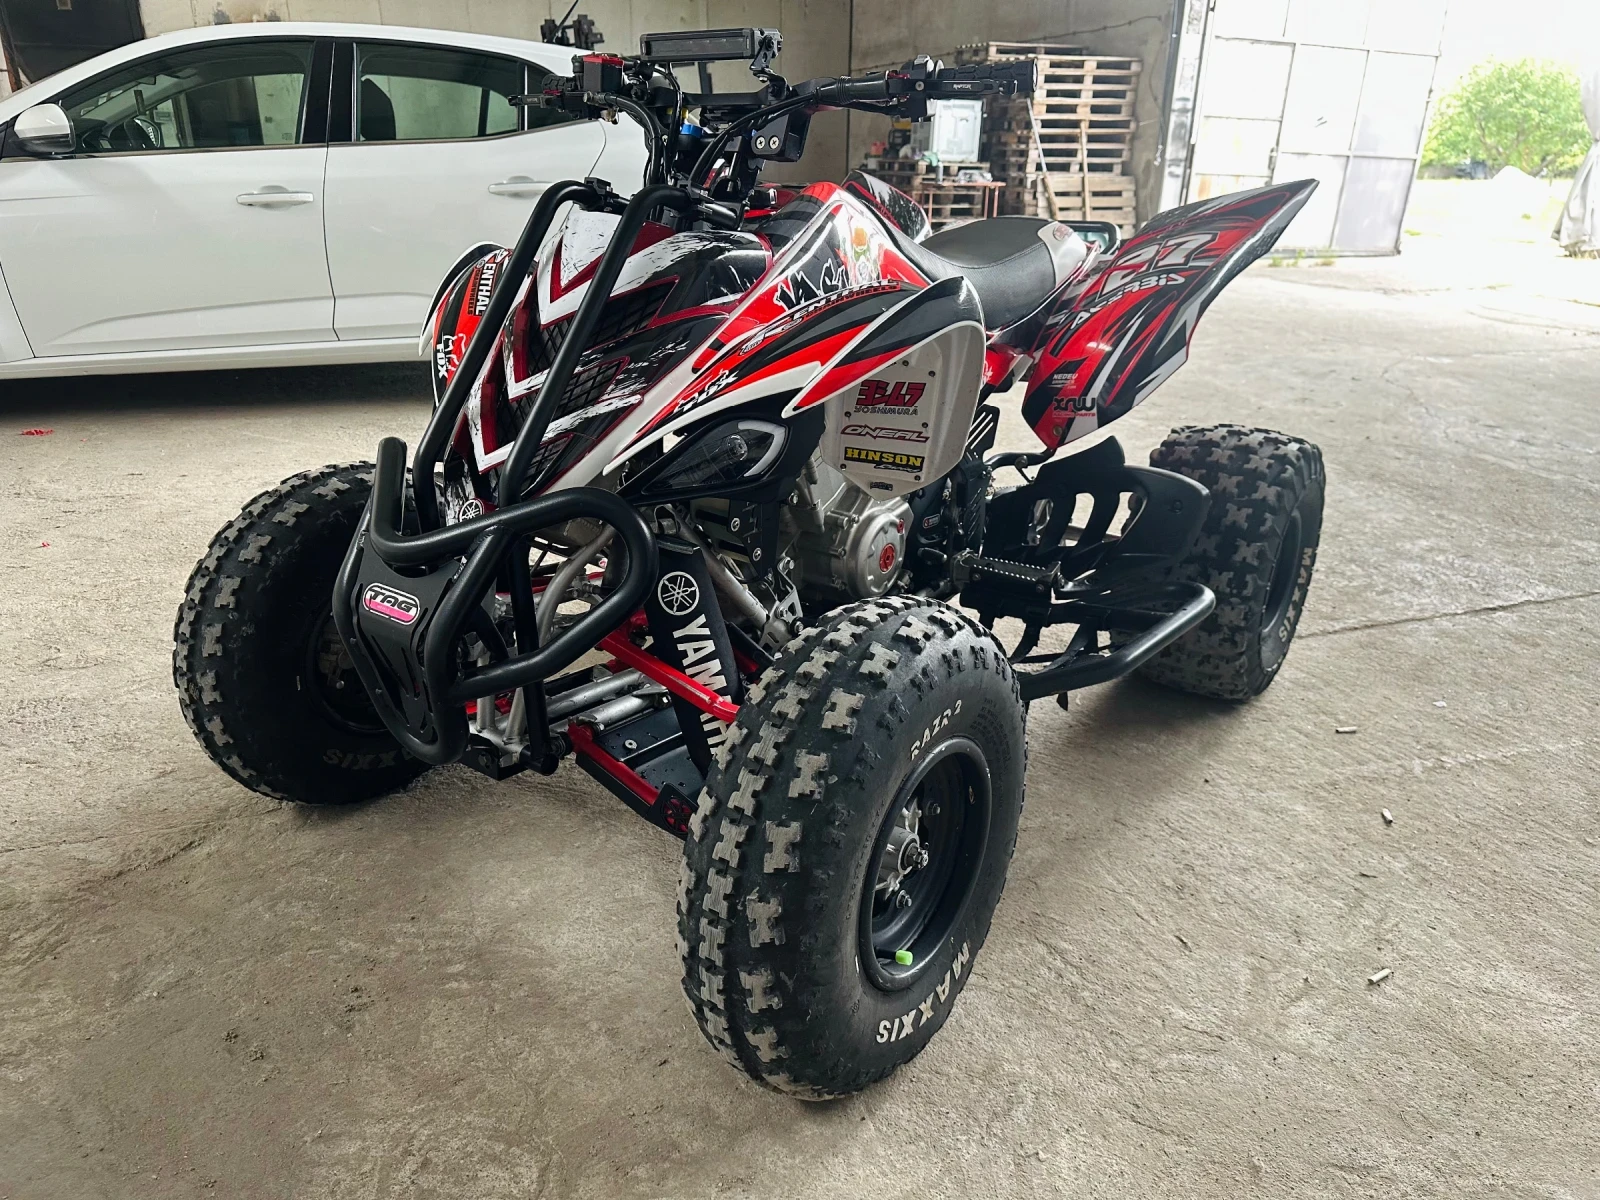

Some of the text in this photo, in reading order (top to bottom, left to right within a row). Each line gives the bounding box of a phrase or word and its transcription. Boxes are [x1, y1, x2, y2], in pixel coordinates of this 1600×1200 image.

[854, 406, 918, 415] YOSHIMURA
[846, 448, 922, 467] HINSON
[1279, 547, 1313, 642] MAXXIS
[876, 941, 971, 1044] MAXXIS
